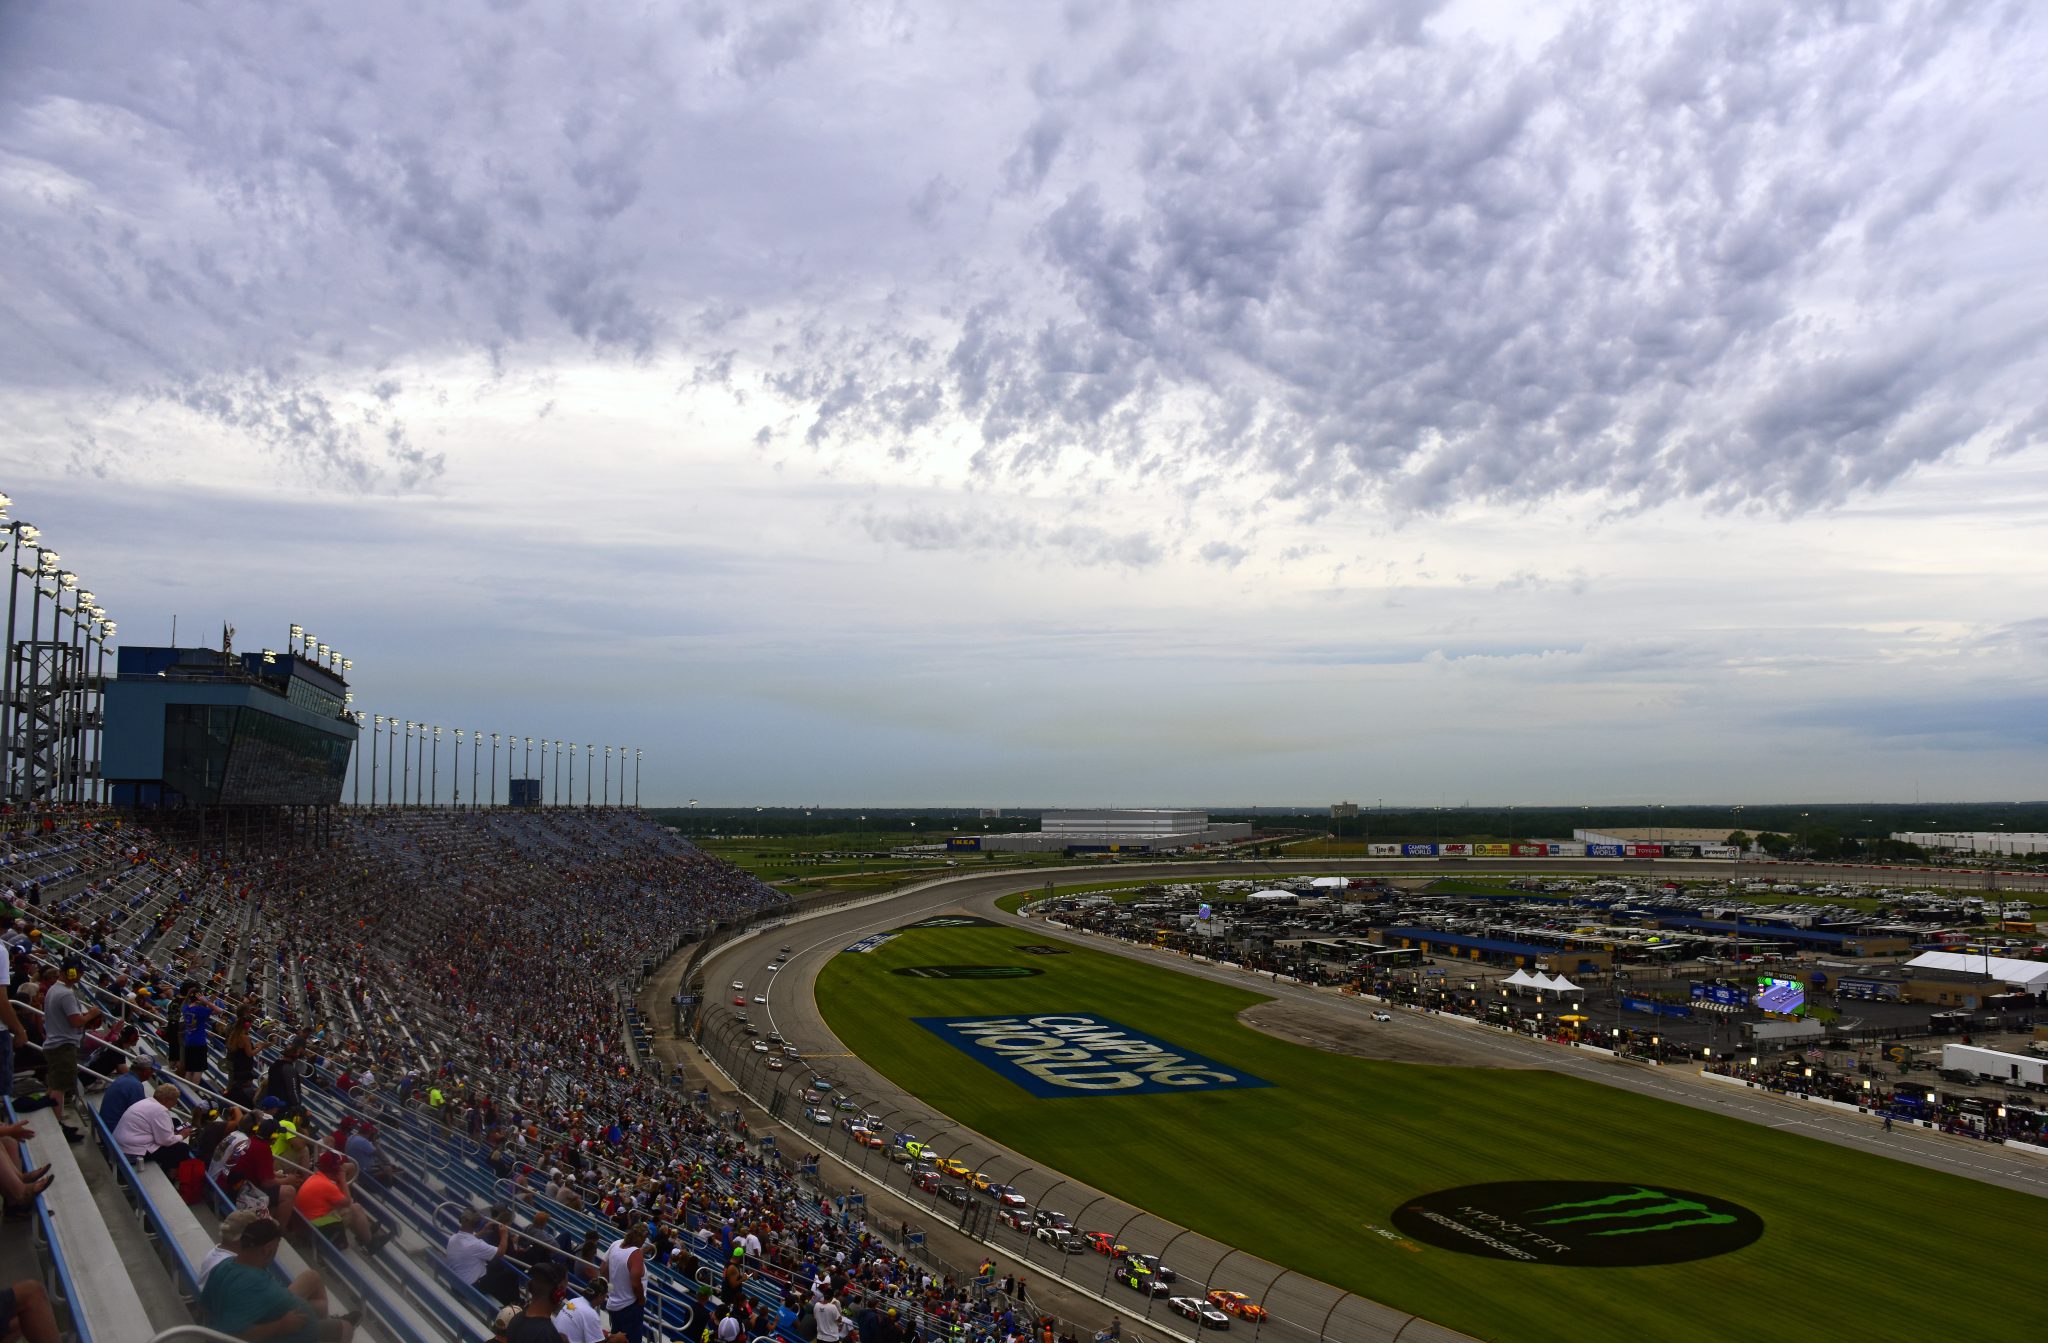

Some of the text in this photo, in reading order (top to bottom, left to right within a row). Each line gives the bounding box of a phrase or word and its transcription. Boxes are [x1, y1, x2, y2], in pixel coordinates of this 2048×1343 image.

[946, 1018, 1145, 1091] WORLD
[1027, 1016, 1238, 1086] CAMPING
[1226, 1301, 1235, 1311] 42
